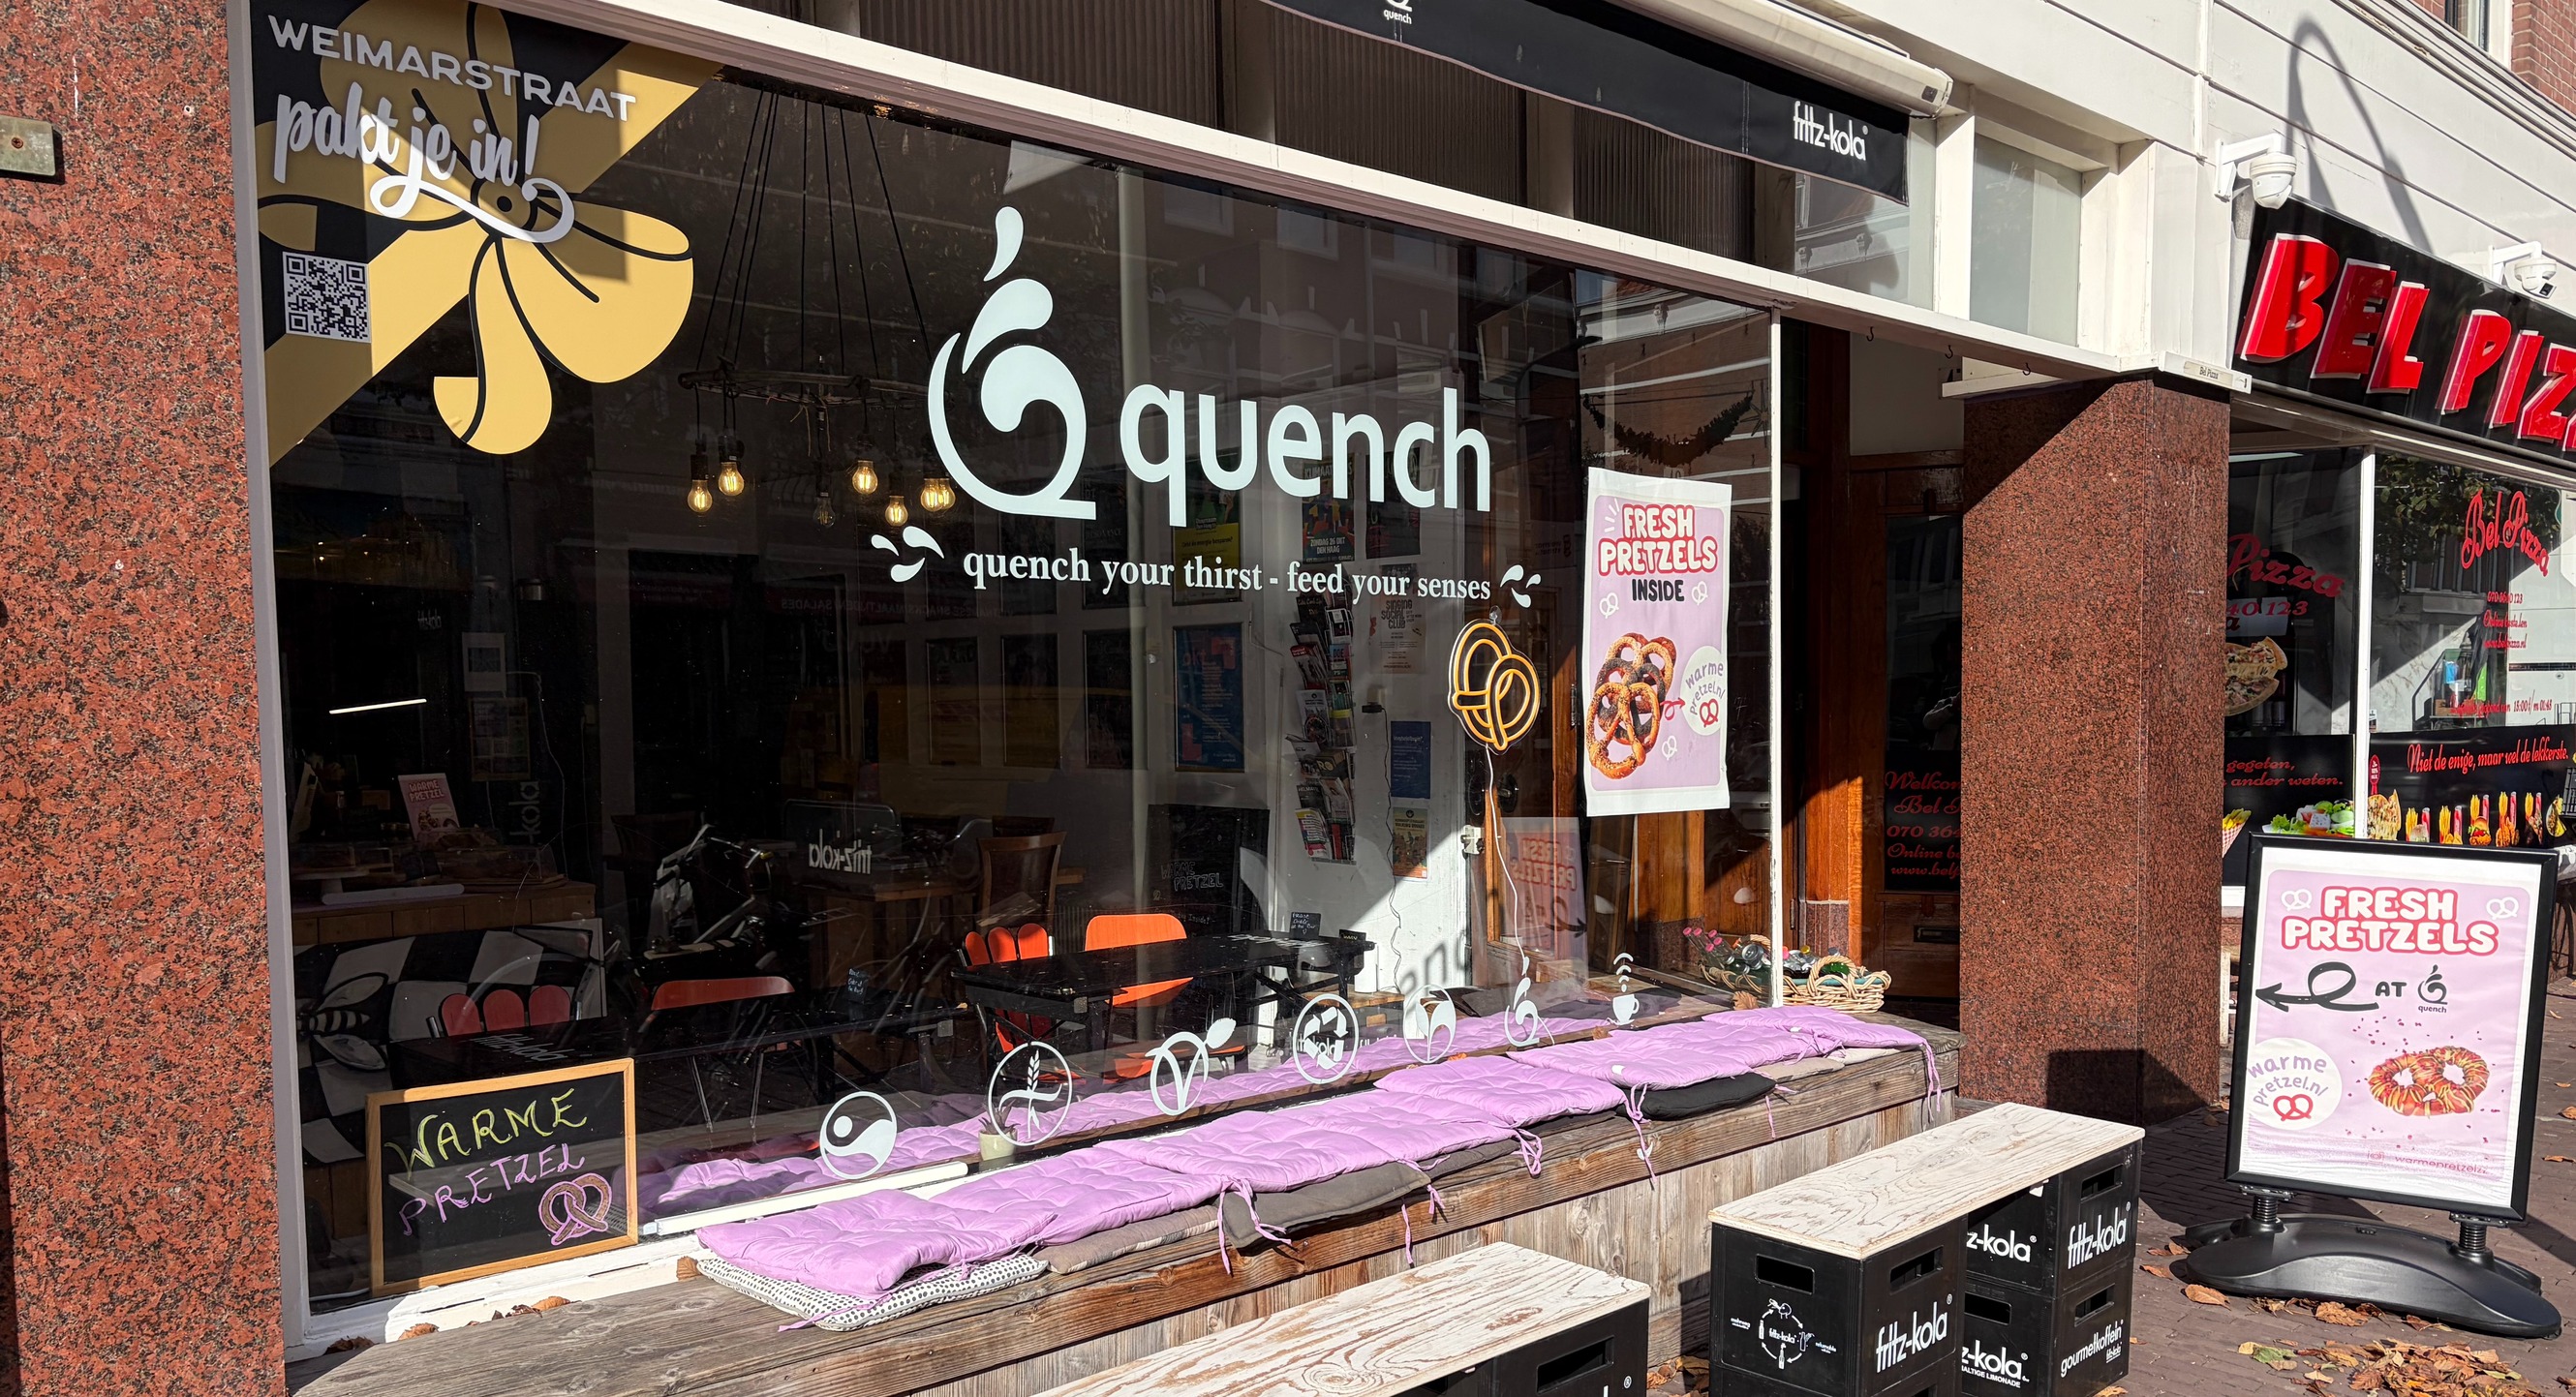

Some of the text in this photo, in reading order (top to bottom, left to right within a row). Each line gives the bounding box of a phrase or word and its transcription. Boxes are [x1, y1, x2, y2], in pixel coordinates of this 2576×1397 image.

[1384, 10, 1412, 24] quench
[268, 15, 636, 123] WEIMARSTRAAT
[1794, 101, 1866, 161] fritz-kola
[2236, 232, 2576, 453] BEL PIZ
[1119, 384, 1491, 527] quench
[1622, 504, 1695, 539] FRESH
[2461, 488, 2550, 577] Bel Pizza
[1598, 536, 1718, 576] PRETZELS
[964, 547, 1091, 590] quench
[1099, 557, 1175, 594] your
[1183, 555, 1263, 591] thirst
[1287, 561, 1344, 593] feed
[1352, 574, 1410, 605] your
[1418, 576, 1491, 599] senses
[1632, 579, 1685, 602] INSIDE
[2266, 600, 2308, 617] 123
[1685, 661, 1724, 690] warme
[2407, 744, 2434, 773] Niet
[2435, 744, 2446, 771] de
[2448, 748, 2476, 774] enige,
[2477, 751, 2503, 767] maar
[2504, 739, 2520, 765] wel
[2520, 738, 2530, 763] de
[2531, 736, 2569, 762] lekkerste.
[409, 779, 440, 793] WARME
[409, 788, 445, 803] PRETZEL
[2230, 772, 2344, 787] ander weten.
[1893, 795, 1940, 814] Bel
[1886, 826, 1924, 837] 070
[1886, 842, 1943, 858] Online
[1174, 872, 1224, 892] PRETZEL
[2321, 886, 2458, 922] FRESH
[2281, 916, 2499, 957] PRETZELS
[2375, 981, 2407, 997] AT
[2417, 1004, 2447, 1014] quench
[2246, 1055, 2327, 1079] warme
[383, 1087, 588, 1180] WARME
[398, 1142, 586, 1236] PRETZEL
[2068, 1206, 2127, 1269] fritz-kola
[1876, 1301, 1947, 1373] fritz-kola
[1986, 1373, 2021, 1388] LIMONADE
